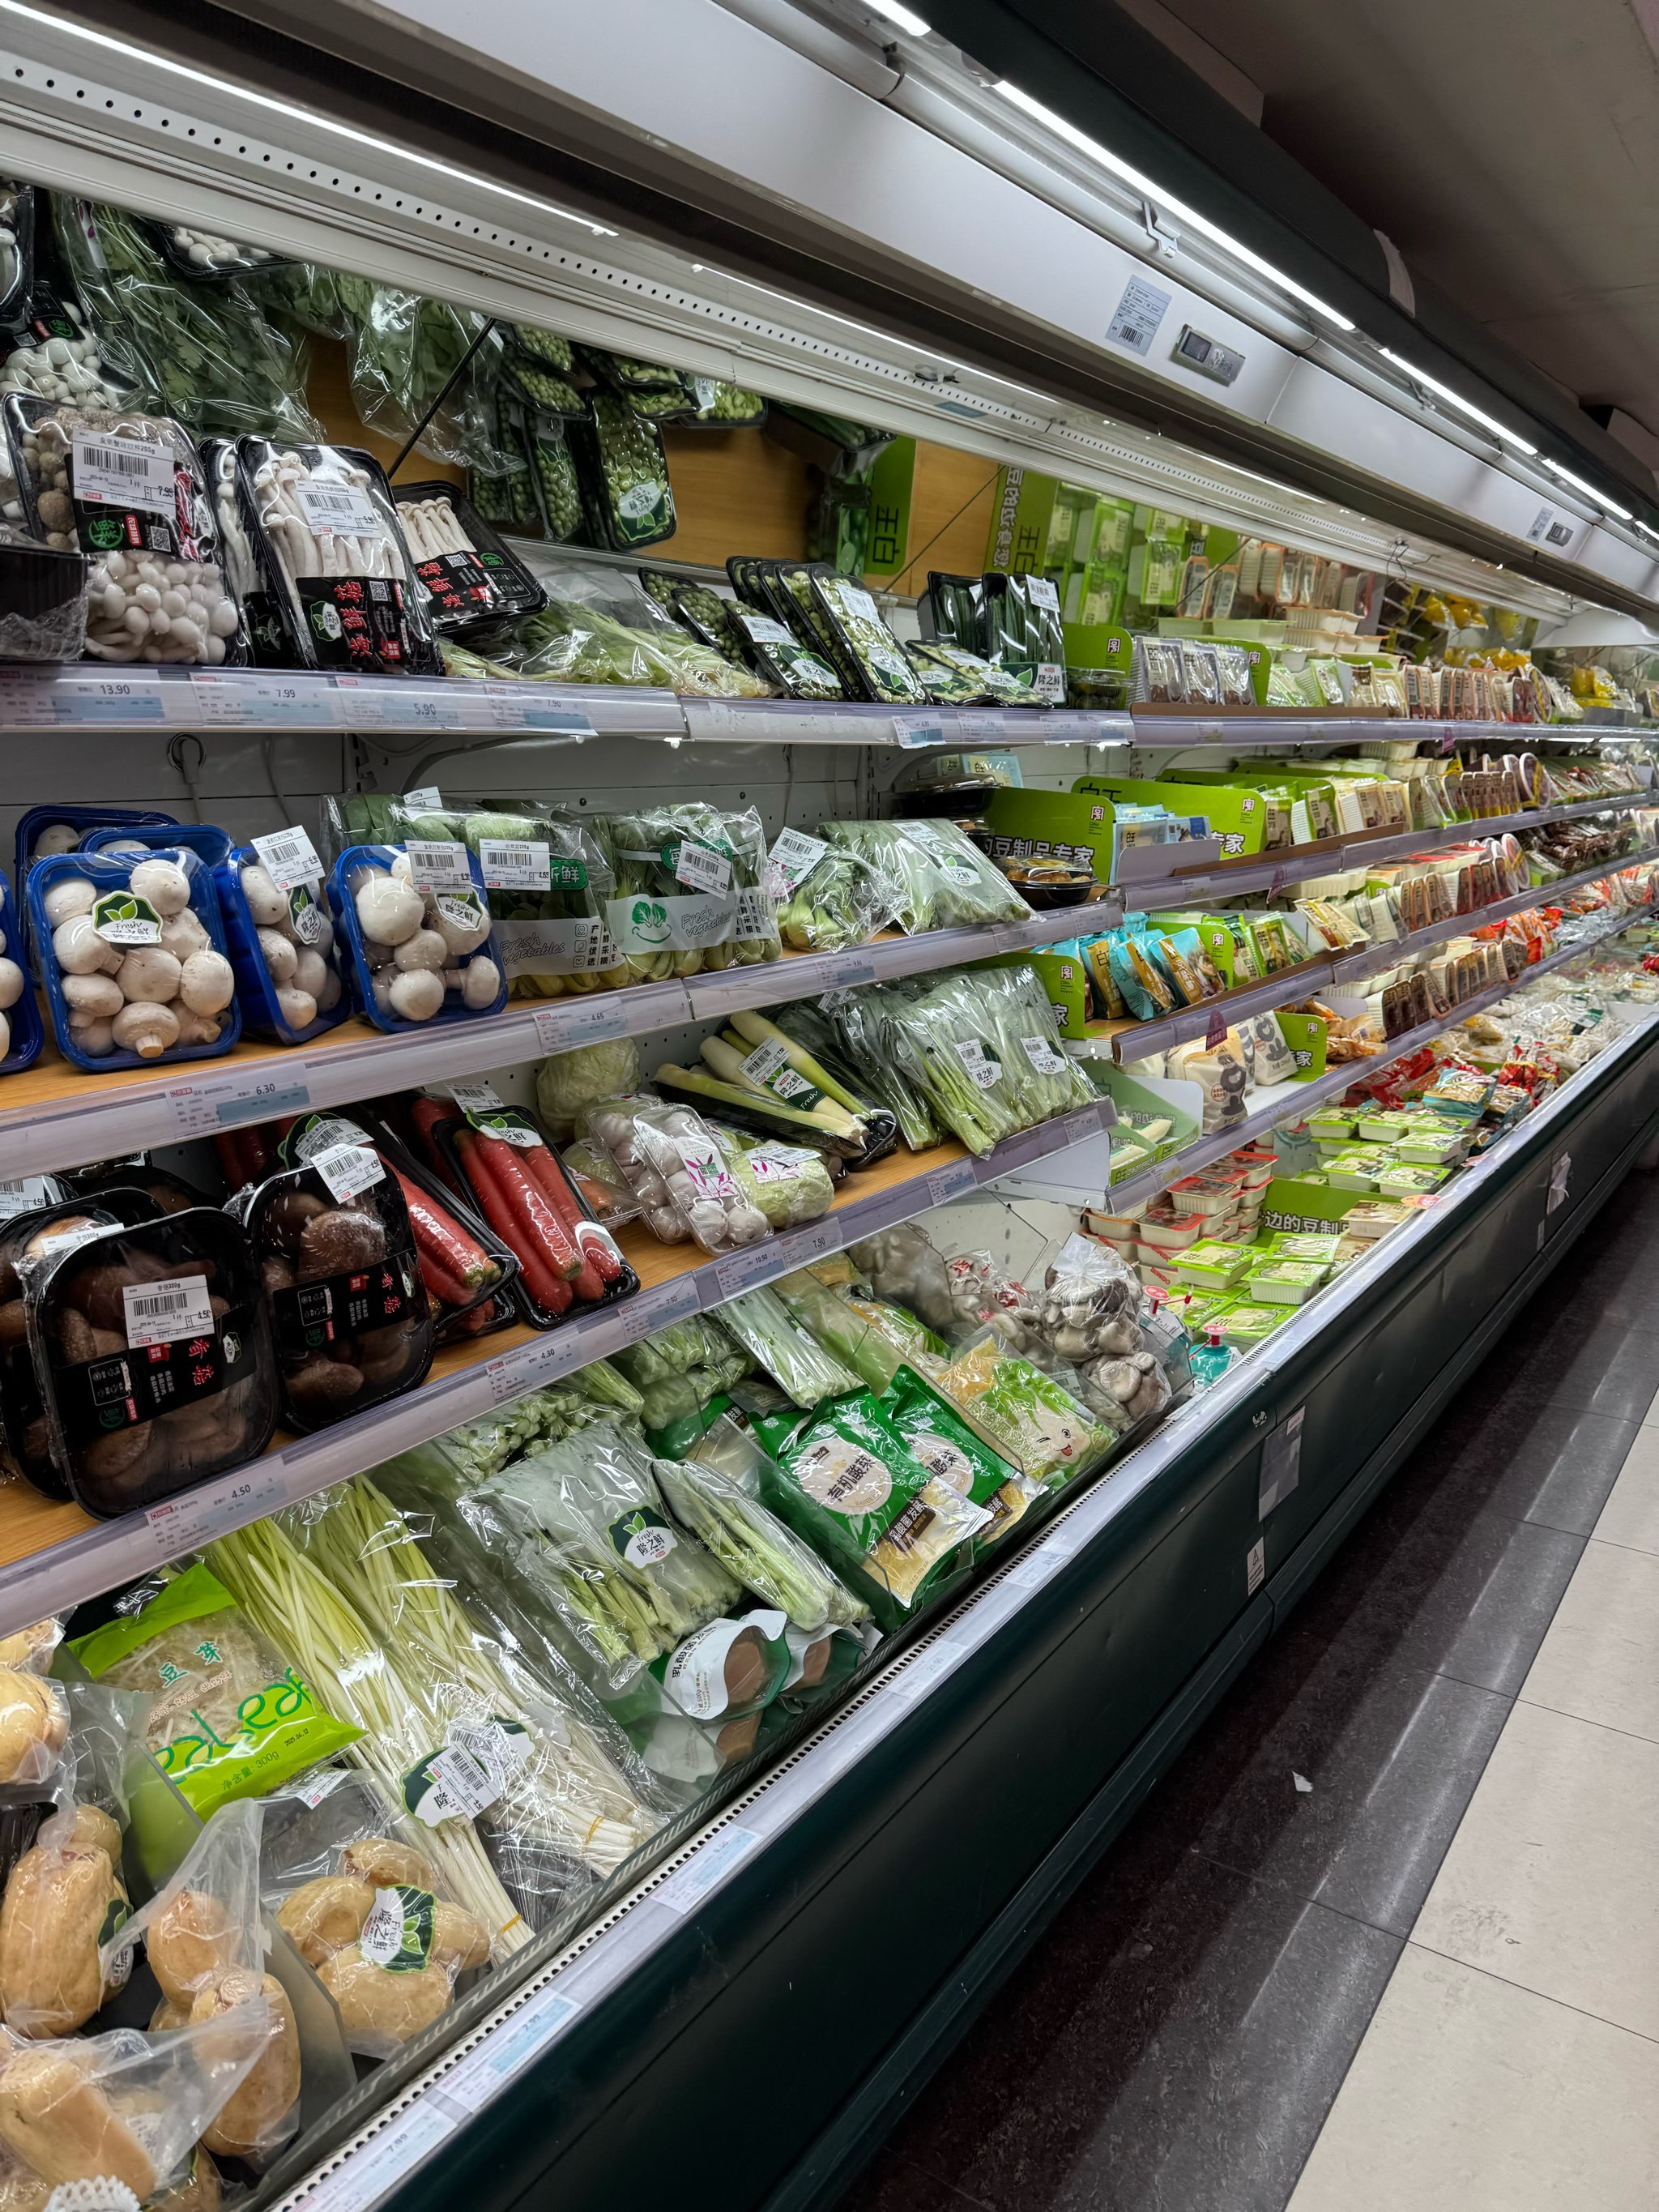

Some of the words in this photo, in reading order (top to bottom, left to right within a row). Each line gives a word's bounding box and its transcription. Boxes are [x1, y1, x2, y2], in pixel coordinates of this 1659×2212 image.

[334, 581, 373, 657] 海鲜菇
[1038, 673, 1060, 686] 隆之鲜
[100, 685, 130, 695] 13.90
[276, 690, 296, 698] 7.99
[415, 703, 437, 715] 5.90
[446, 903, 474, 923] 隆之鲜
[681, 905, 714, 929] Fresh
[115, 921, 143, 930] Fresh
[686, 912, 731, 937] vegetables
[500, 933, 541, 955] Fresh
[503, 942, 565, 966] vegetables
[587, 925, 599, 967] 产地优选
[591, 1013, 604, 1021] 4.69
[256, 1083, 275, 1095] 6.30
[800, 1091, 818, 1110] Fresh
[382, 1272, 401, 1313] 香菇
[189, 1339, 215, 1386] 香菇
[541, 1348, 555, 1360] 4.30
[827, 1454, 876, 1501] 有机酸菜
[232, 1484, 250, 1499] 4.50
[636, 1534, 665, 1556] 隆之鲜
[637, 1530, 654, 1542] Fresh
[158, 1641, 224, 1689] 豆芽
[174, 1689, 199, 1707] 好豆
[284, 1727, 309, 1747] 2025.04.12
[255, 1750, 279, 1768] 300g
[372, 1908, 392, 1951] 隆之鲜
[389, 1919, 401, 1951] Fresh
[387, 2133, 409, 2153] 7.99
